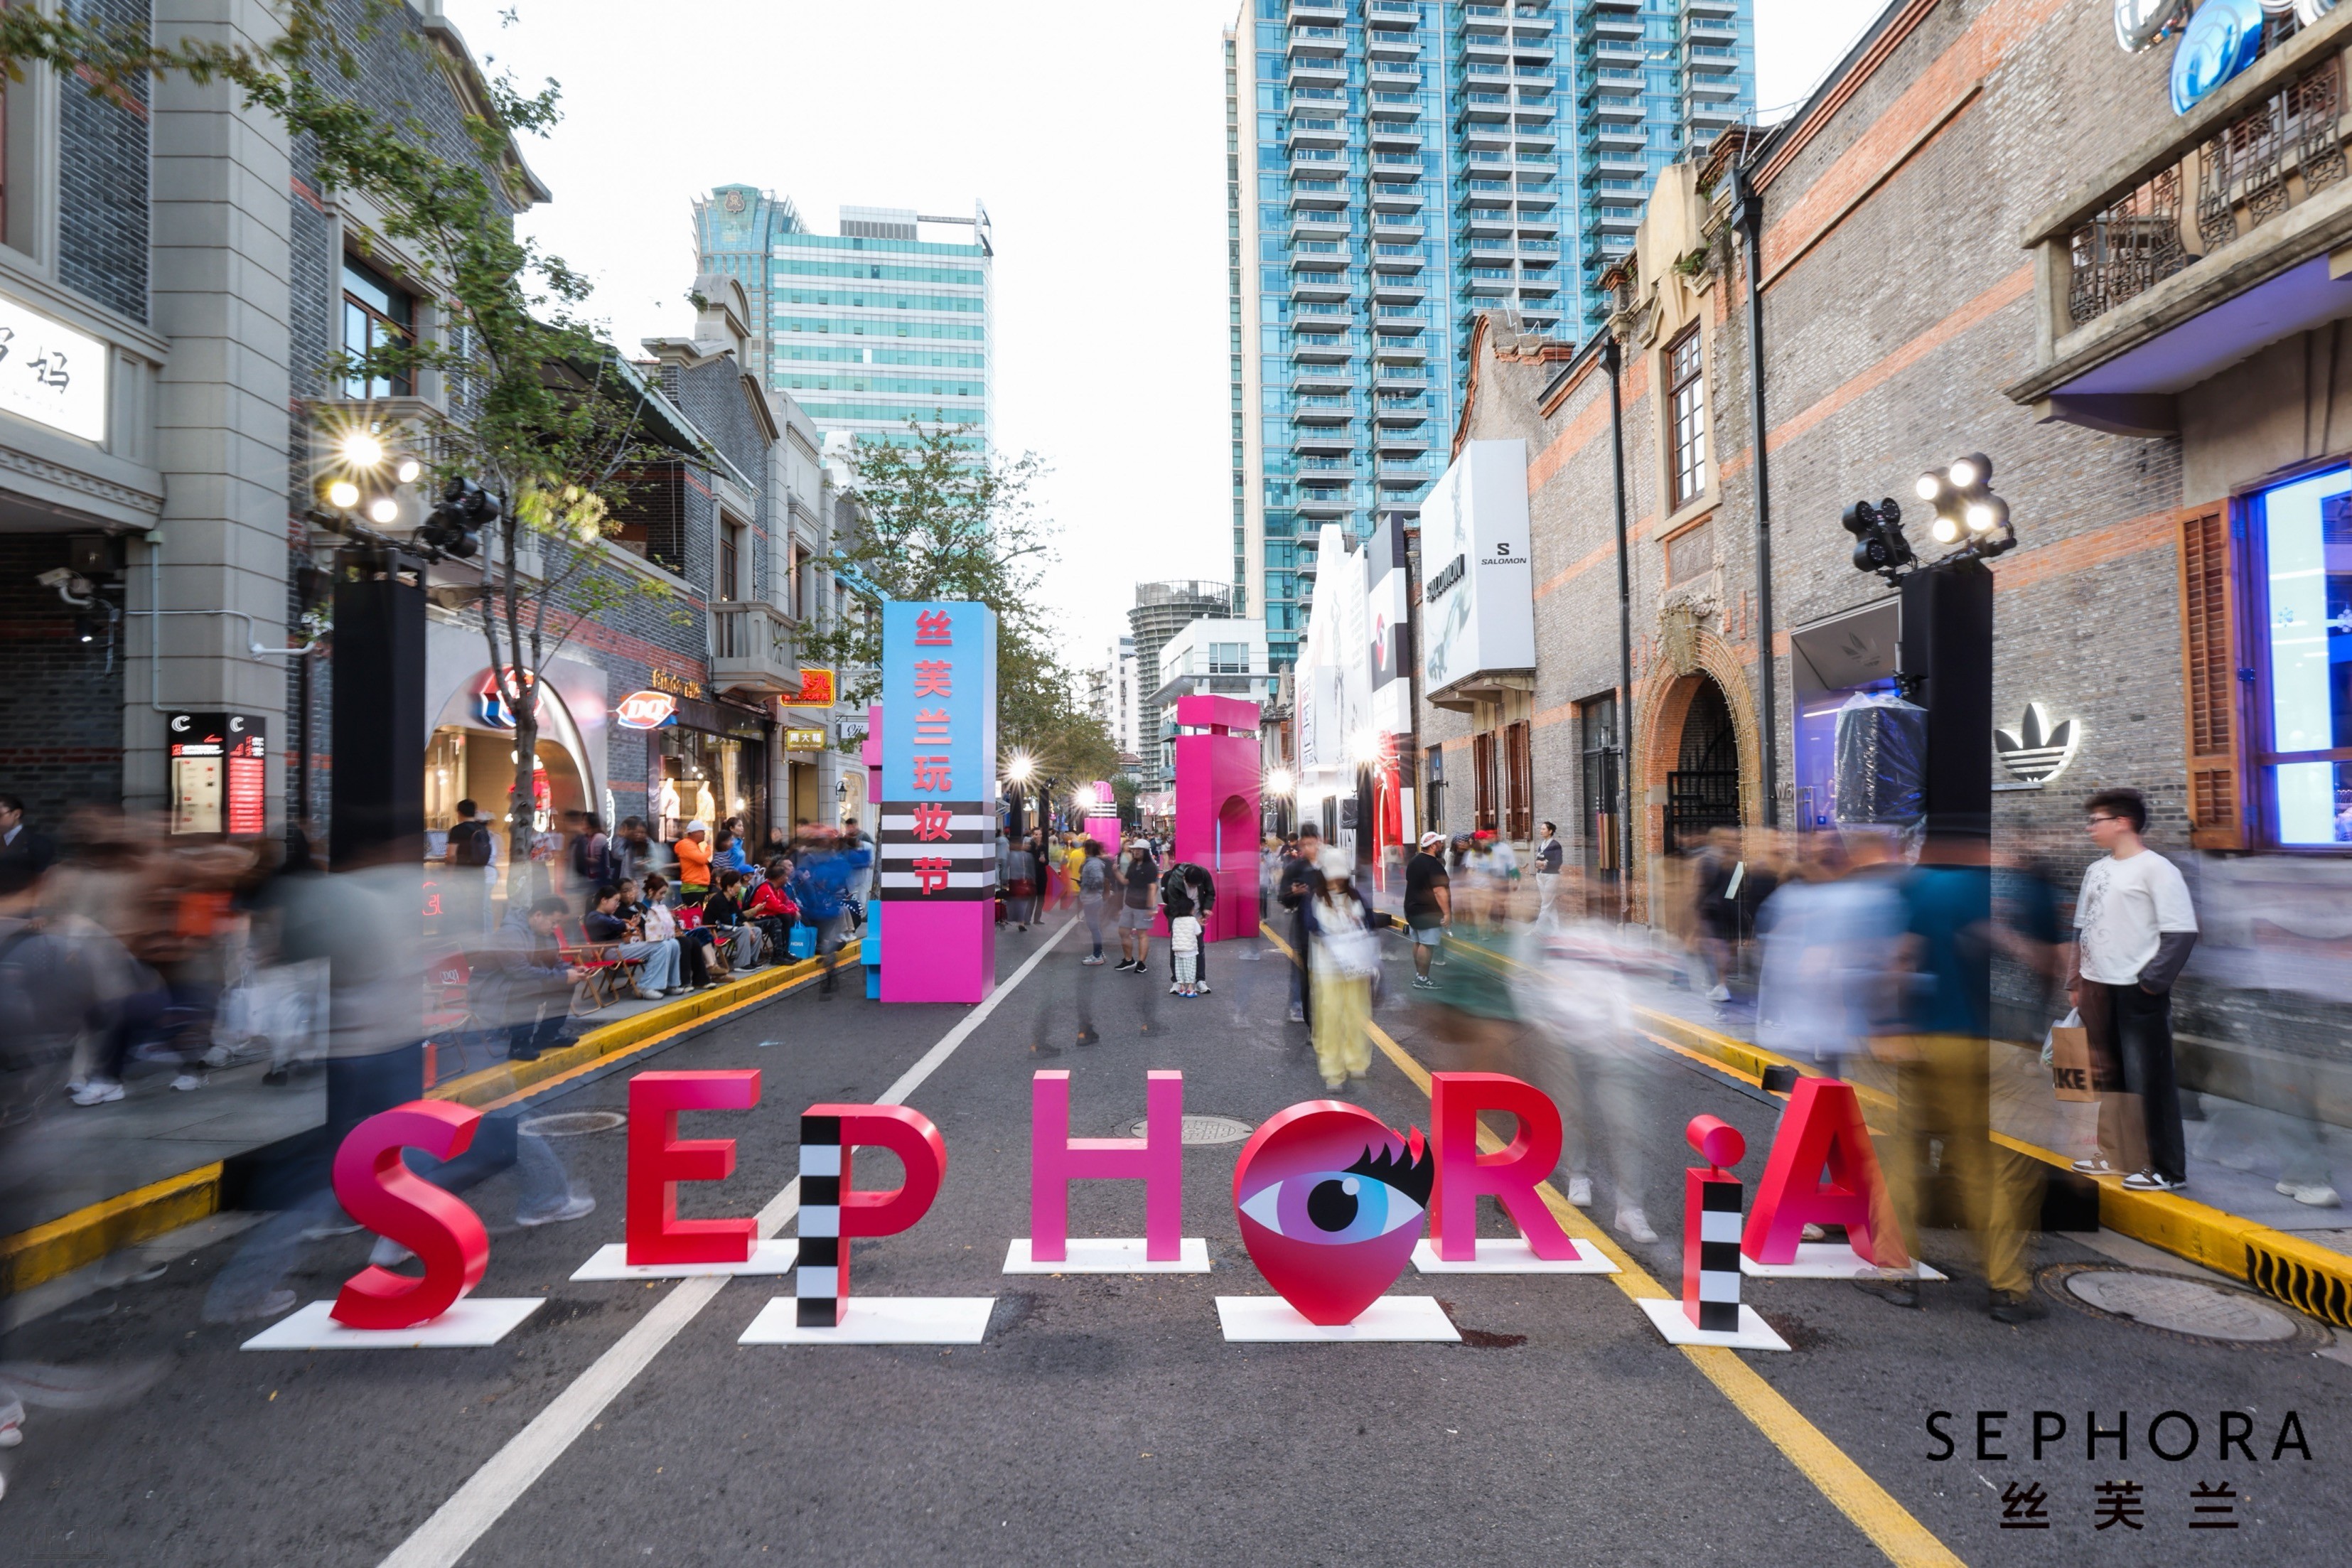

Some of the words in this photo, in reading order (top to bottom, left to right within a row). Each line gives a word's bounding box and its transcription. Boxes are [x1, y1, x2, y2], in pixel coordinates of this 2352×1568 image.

[1497, 542, 1510, 556] S
[1481, 557, 1527, 566] SALOMON
[1426, 553, 1466, 603] SALOMON
[625, 699, 667, 721] DQ
[912, 608, 953, 896] 丝芙兰玩妆节
